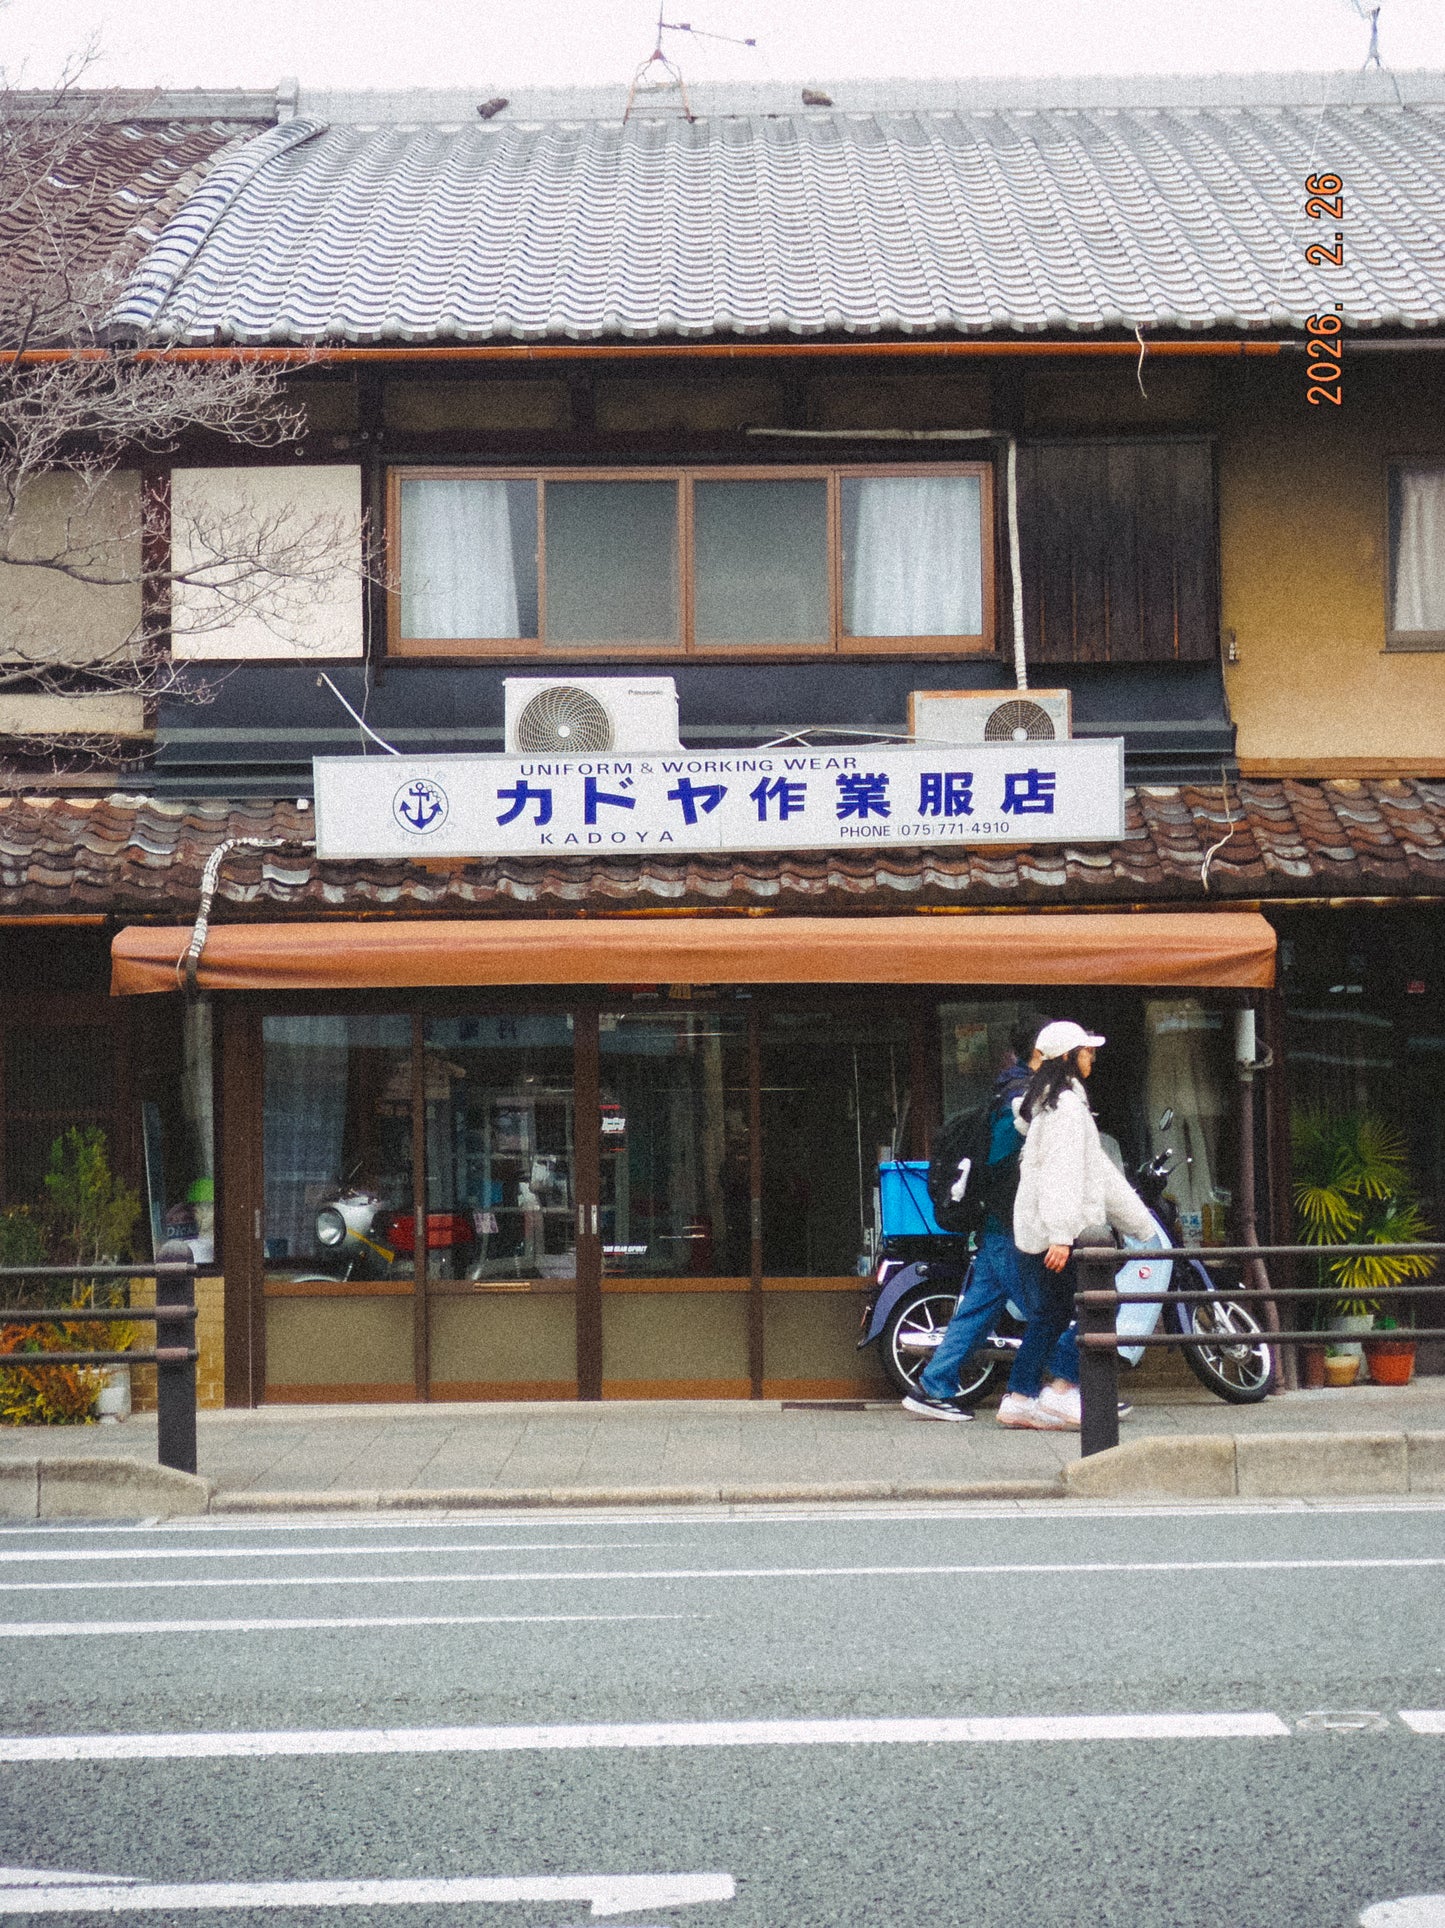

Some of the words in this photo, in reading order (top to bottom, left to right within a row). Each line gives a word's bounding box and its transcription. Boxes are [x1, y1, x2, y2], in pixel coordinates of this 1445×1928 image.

[520, 762, 632, 776] UNIFORM
[641, 763, 653, 773] &
[661, 760, 773, 773] WORKING
[783, 757, 857, 770] WEAR
[496, 768, 1057, 827] カドヤ作業服店
[540, 830, 674, 845] KADOYA
[840, 825, 890, 838] PHONE
